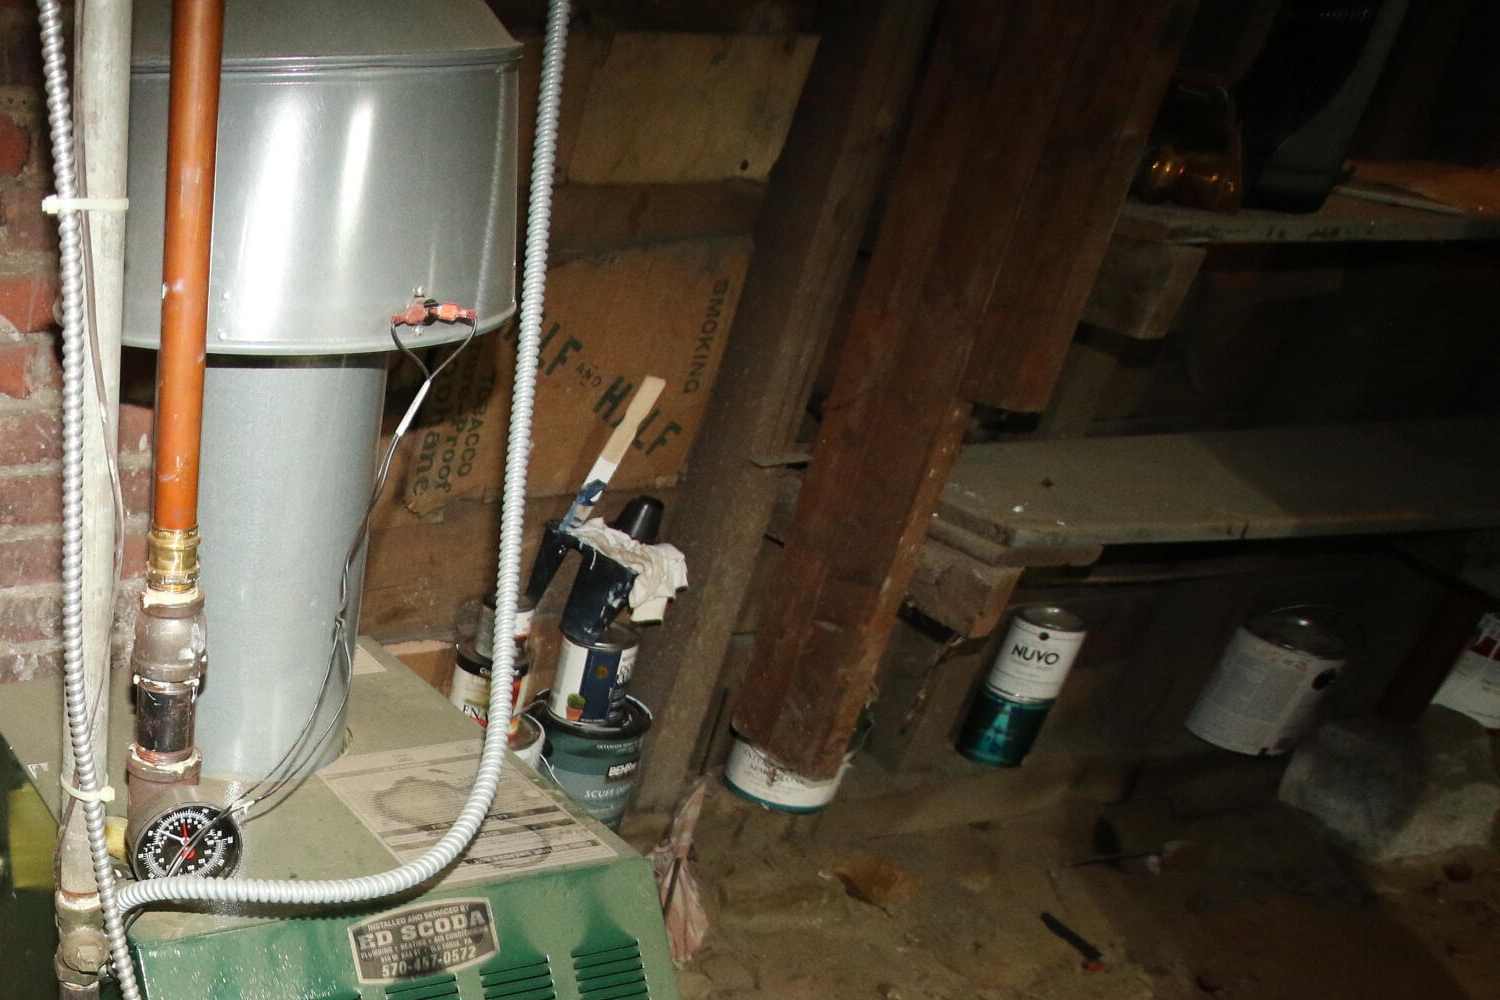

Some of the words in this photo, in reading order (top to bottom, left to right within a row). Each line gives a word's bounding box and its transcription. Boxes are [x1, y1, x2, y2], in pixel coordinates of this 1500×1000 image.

[683, 280, 729, 394] SMOKING
[566, 363, 602, 388] AND
[593, 376, 682, 454] HLF
[1012, 644, 1060, 665] NUVO
[357, 930, 393, 950] ED
[401, 910, 486, 941] SCODA
[368, 919, 406, 931] INSTALLED
[408, 913, 423, 923] AND
[424, 907, 458, 920] SERVICED
[459, 904, 470, 912] BY
